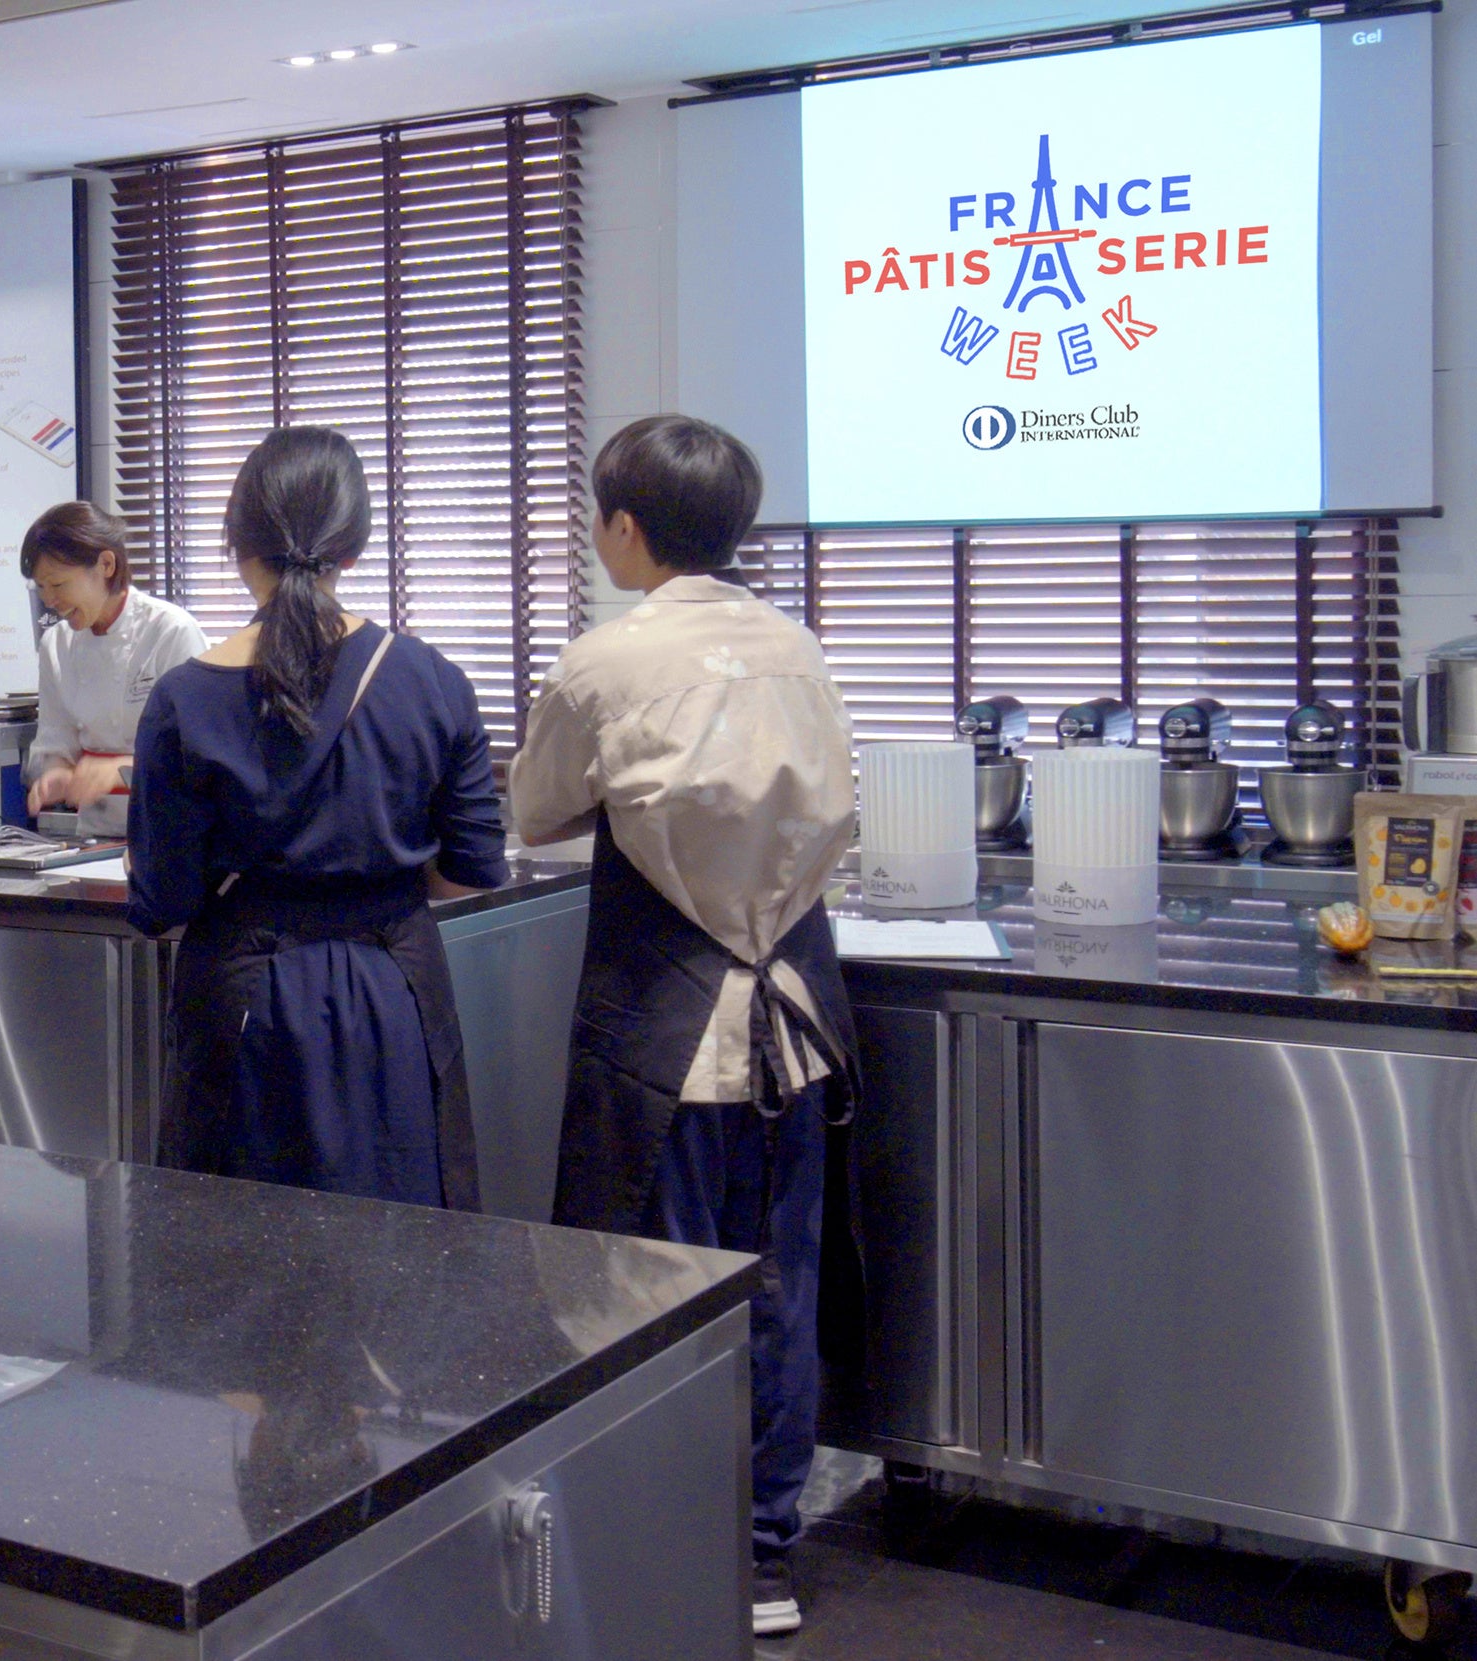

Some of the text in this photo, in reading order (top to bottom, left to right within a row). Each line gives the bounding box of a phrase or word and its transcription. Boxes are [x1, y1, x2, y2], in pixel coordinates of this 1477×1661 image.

[1352, 28, 1382, 46] Gel
[940, 295, 1157, 379] WEEK
[1021, 404, 1139, 428] Diners Club
